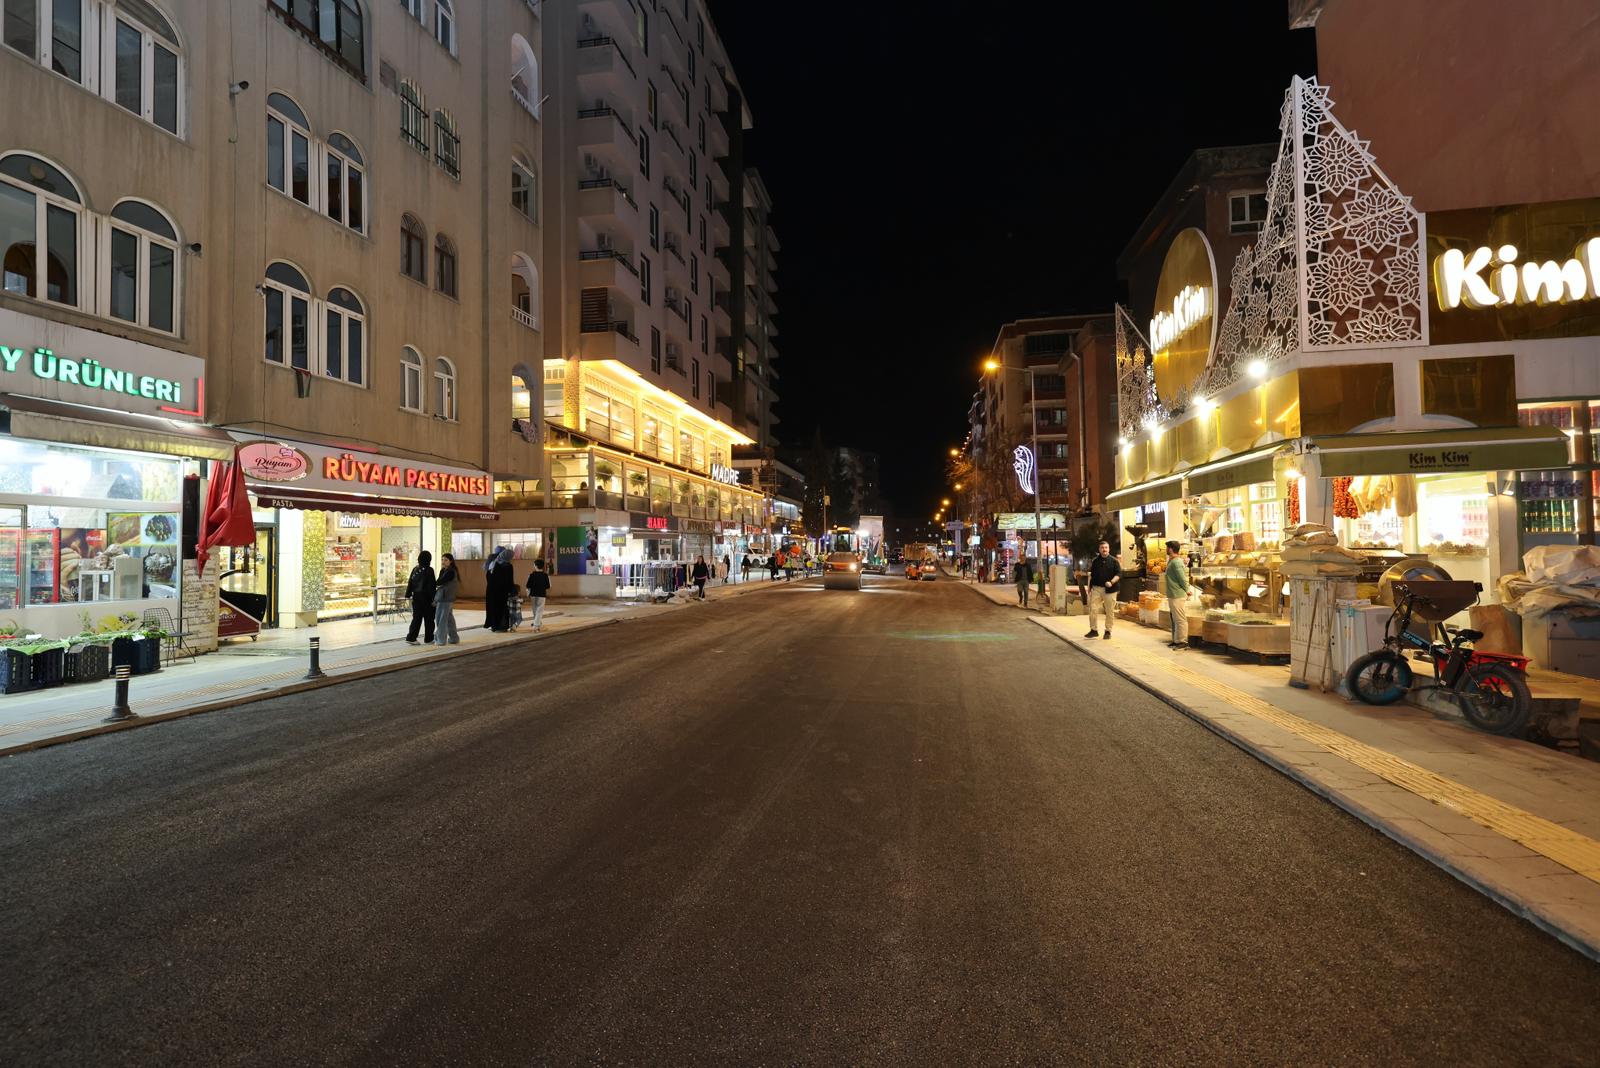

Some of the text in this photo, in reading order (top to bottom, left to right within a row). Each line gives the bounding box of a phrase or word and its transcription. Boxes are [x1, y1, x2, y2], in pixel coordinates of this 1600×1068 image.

[1408, 451, 1469, 464] Kim Kim
[323, 453, 490, 496] RÜYAM PASTANESİ
[712, 463, 740, 486] MADRE
[272, 499, 294, 508] PASTA
[406, 509, 433, 517] DONDURMA
